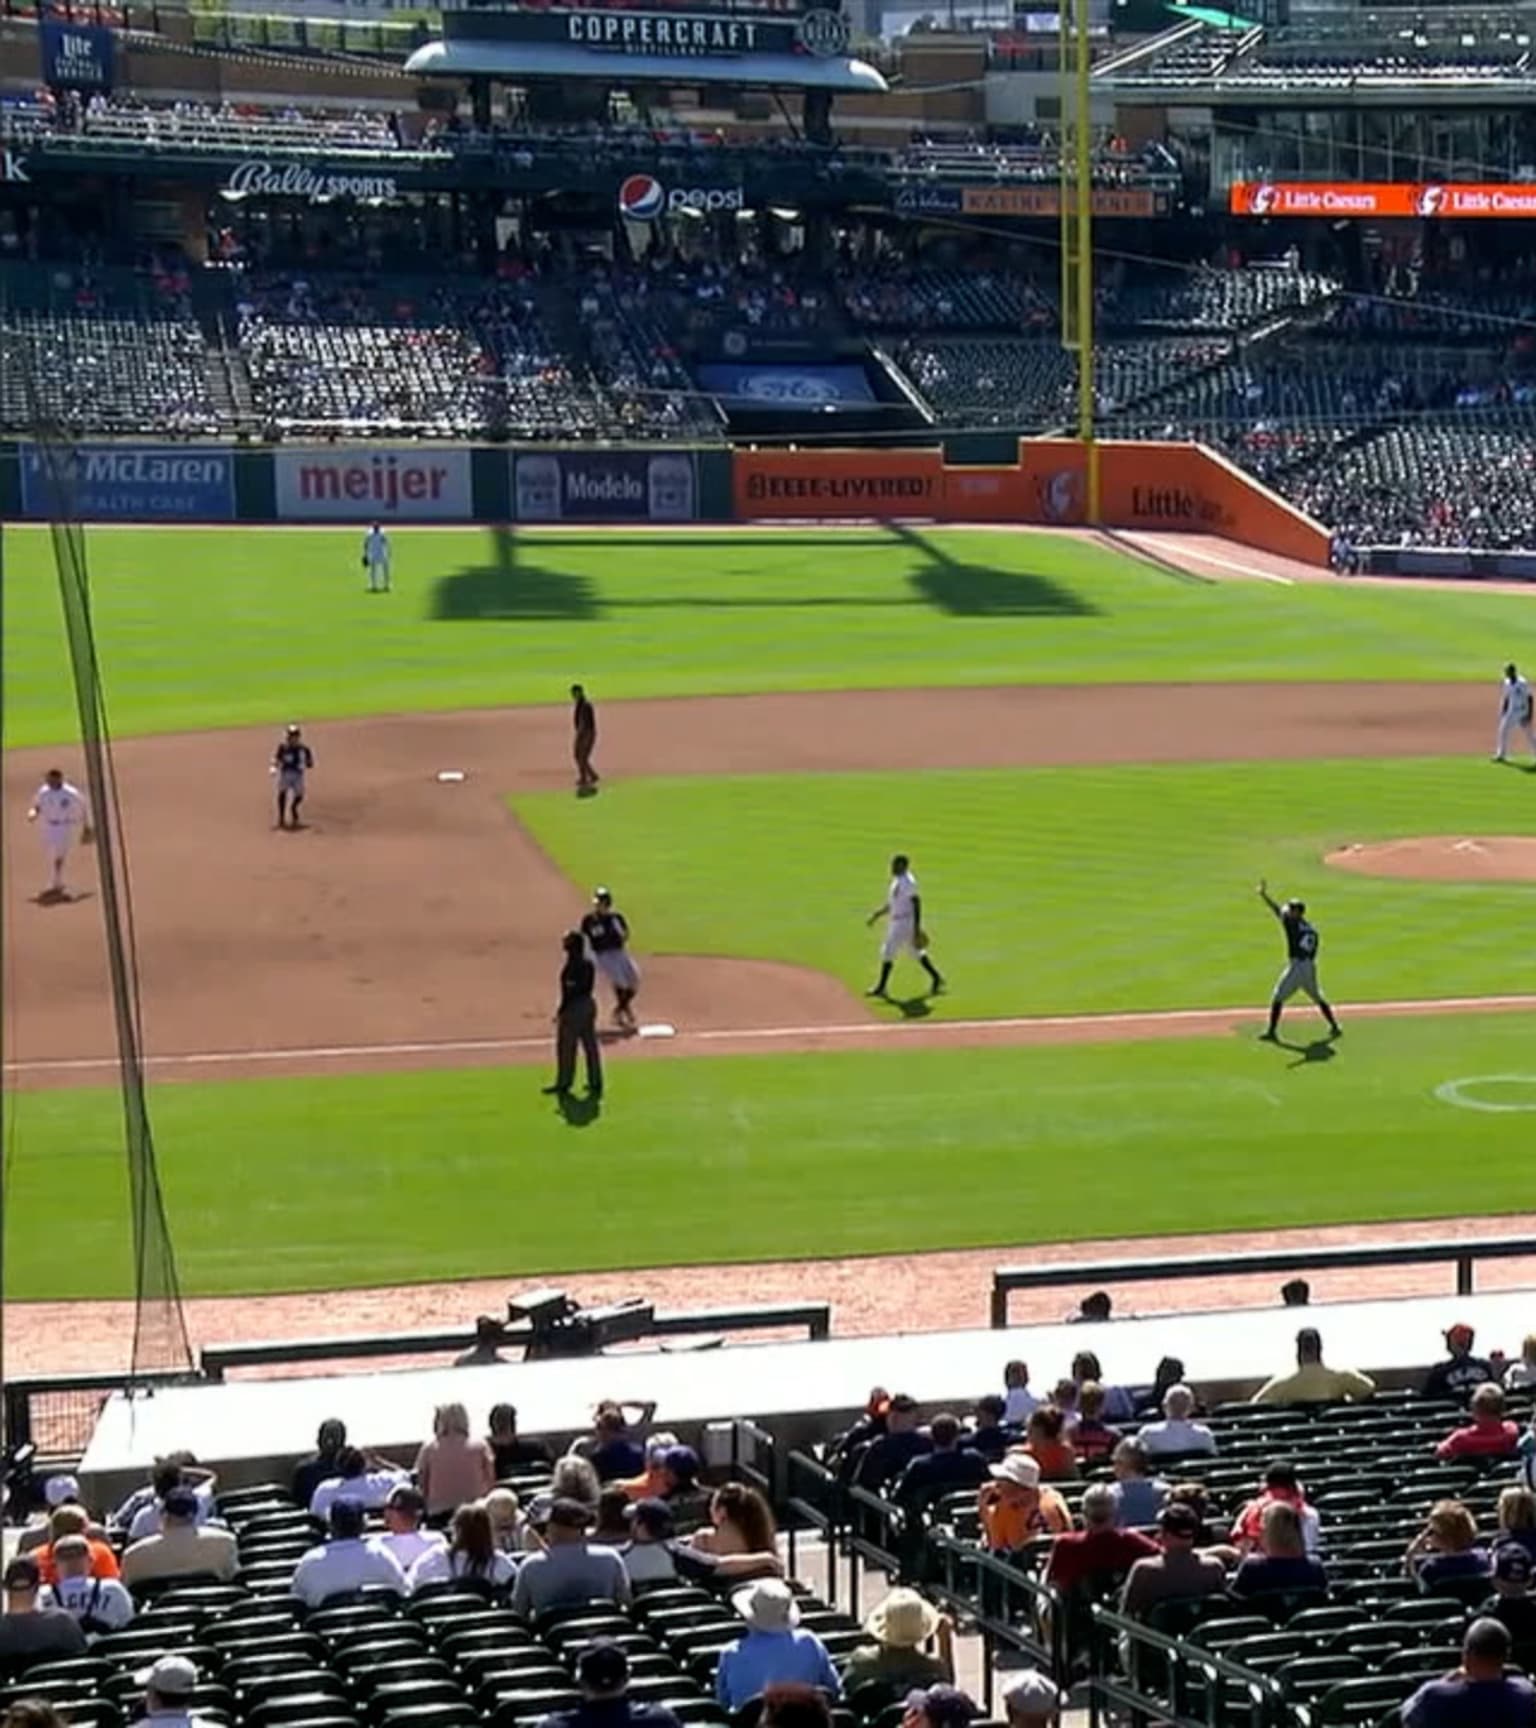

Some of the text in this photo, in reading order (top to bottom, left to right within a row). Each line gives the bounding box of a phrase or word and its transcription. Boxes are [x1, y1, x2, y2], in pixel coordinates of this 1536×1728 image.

[569, 15, 757, 47] COPPERCRAFT
[228, 160, 397, 205] Bally SPORTS
[668, 185, 744, 212] pepsi
[1285, 191, 1376, 209] Little Caesars
[1453, 192, 1490, 210] Little
[85, 455, 224, 483] McLaren
[299, 455, 446, 510] meijer
[567, 472, 642, 500] Modelo
[1132, 485, 1194, 517] Little
